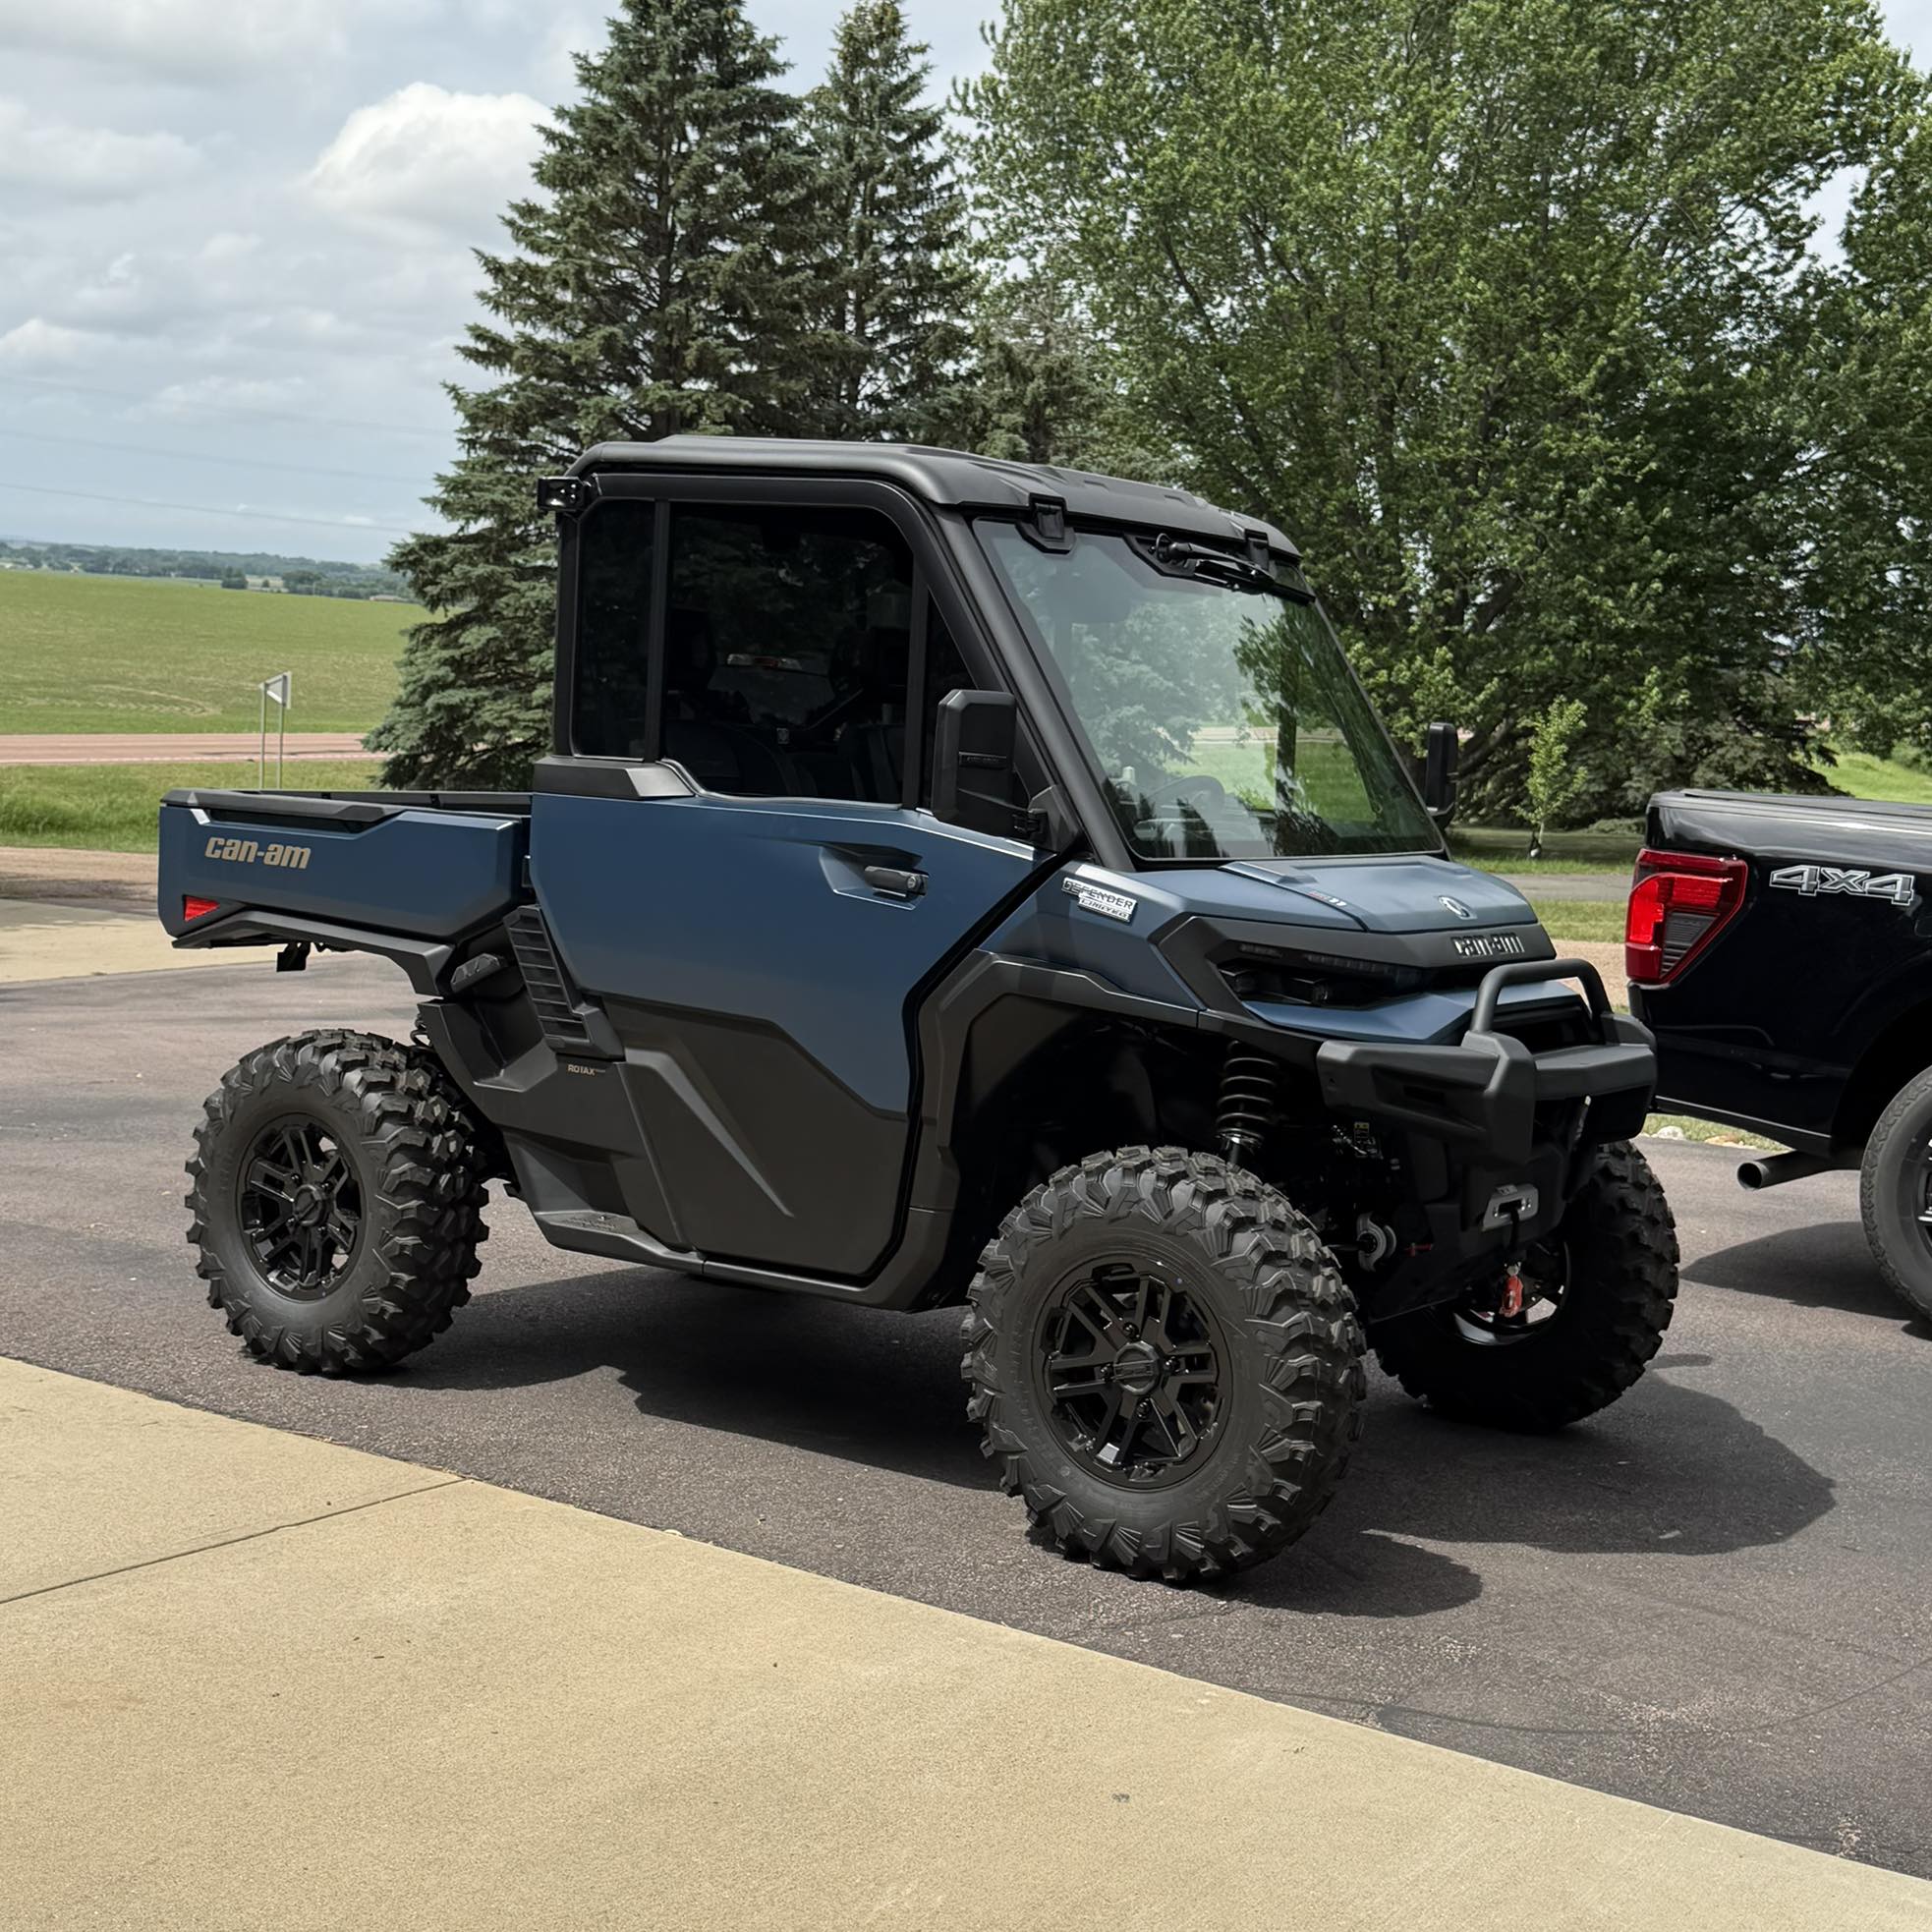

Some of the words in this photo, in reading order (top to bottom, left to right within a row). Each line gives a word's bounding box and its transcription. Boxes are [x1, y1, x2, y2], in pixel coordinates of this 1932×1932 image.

[204, 836, 312, 870] can-am
[1063, 880, 1134, 910] DEFENDER
[567, 1063, 597, 1076] ROTAX
